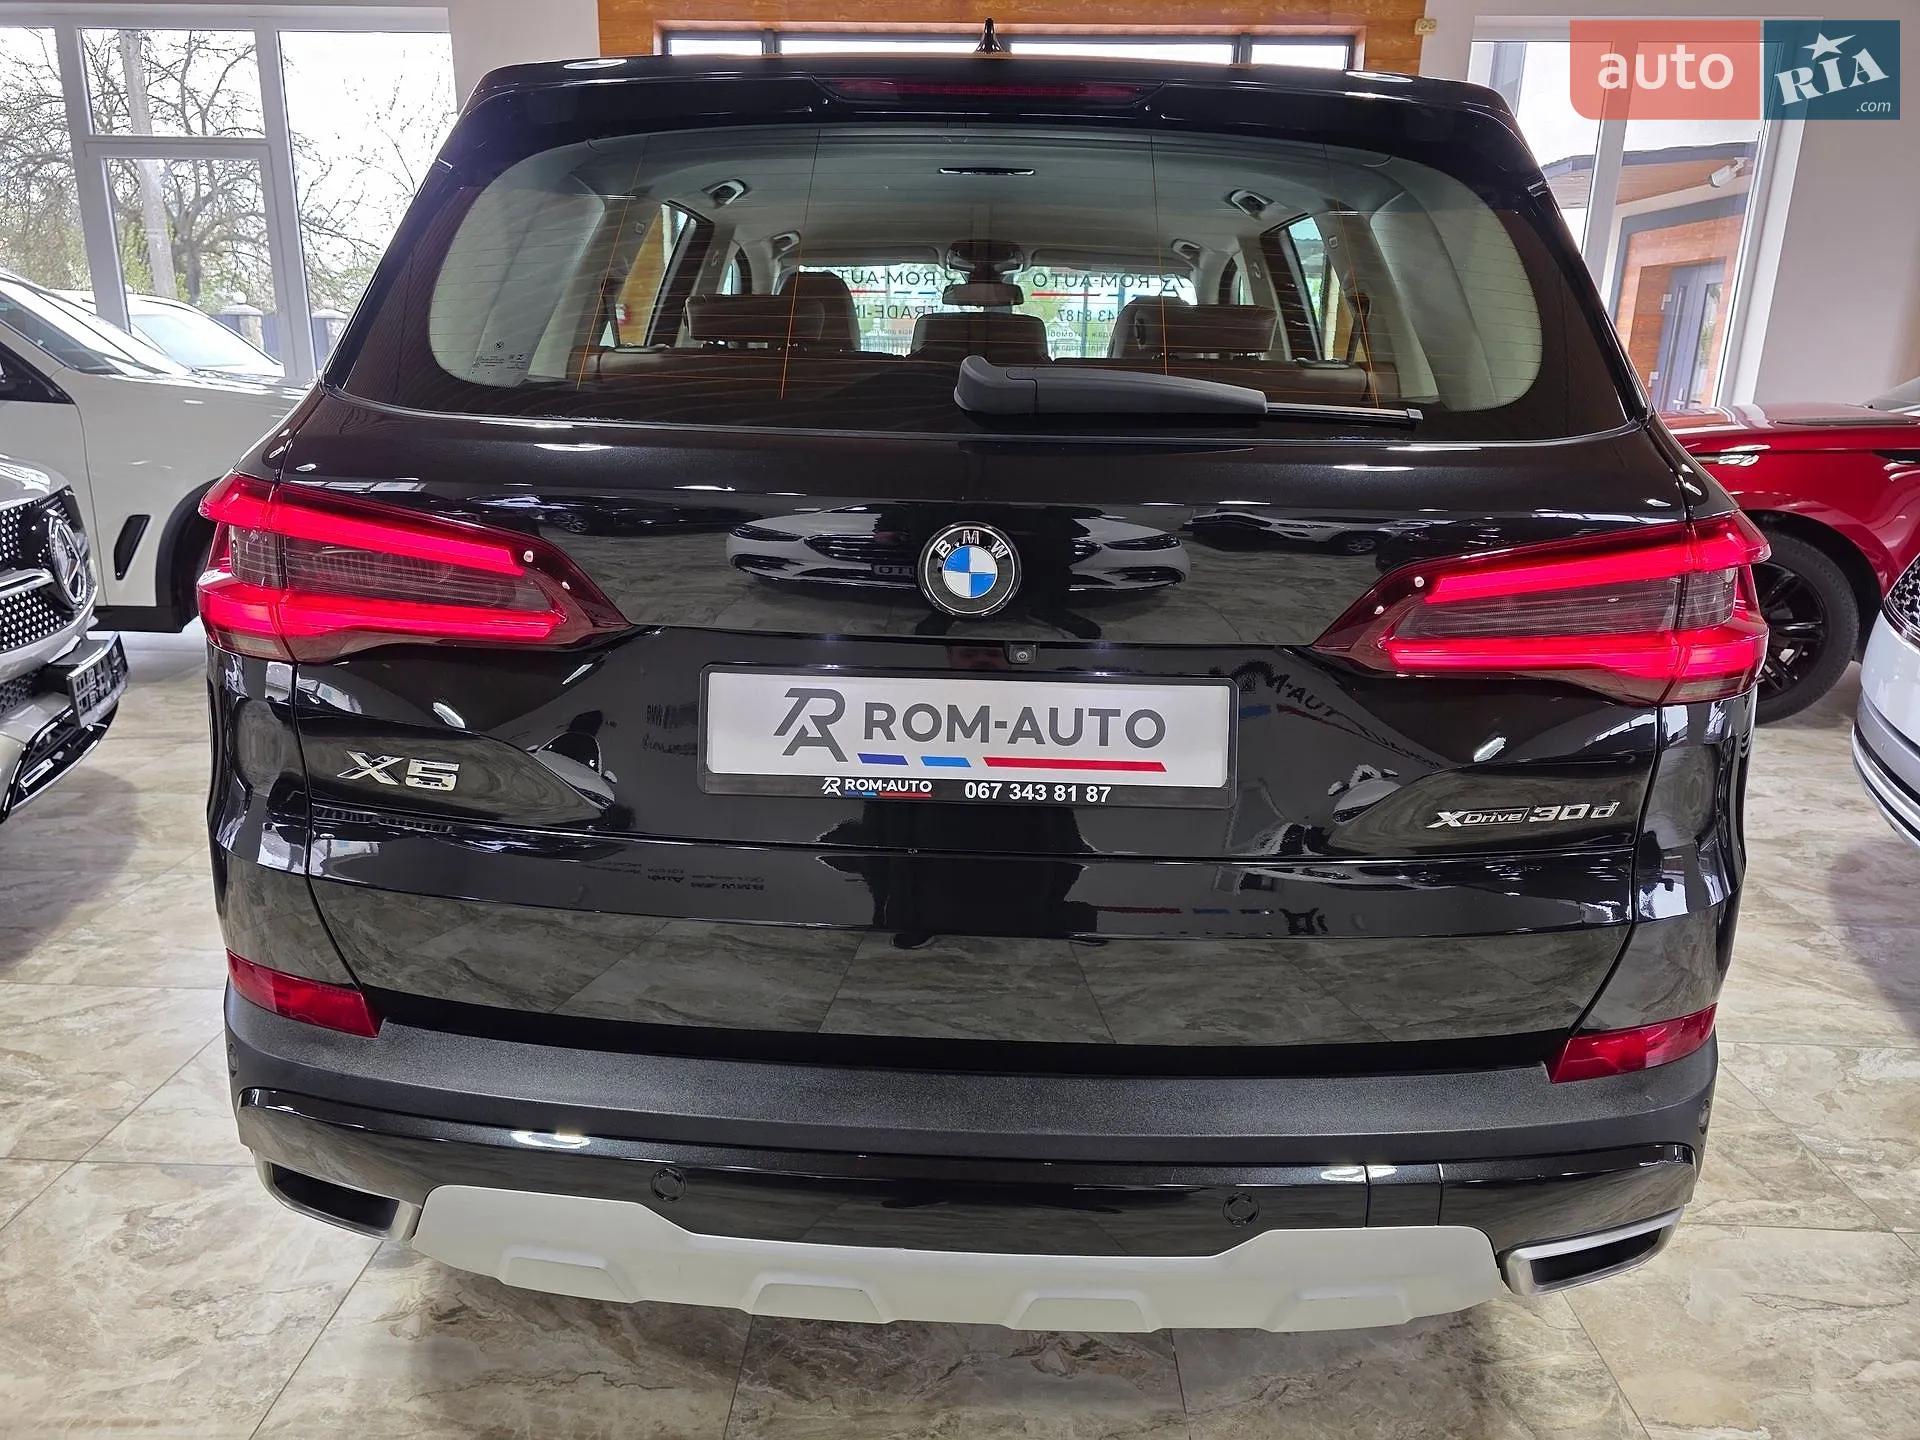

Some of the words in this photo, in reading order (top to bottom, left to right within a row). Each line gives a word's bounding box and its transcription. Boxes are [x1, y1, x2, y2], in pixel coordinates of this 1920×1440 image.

[934, 529, 1009, 560] BMW
[863, 701, 1167, 749] ROM-AUTO
[336, 750, 460, 792] X5
[844, 778, 933, 793] ROM-AUTO
[964, 781, 1002, 799] 067
[1008, 783, 1047, 801] 343
[1053, 785, 1078, 802] 81
[1085, 786, 1112, 803] 87
